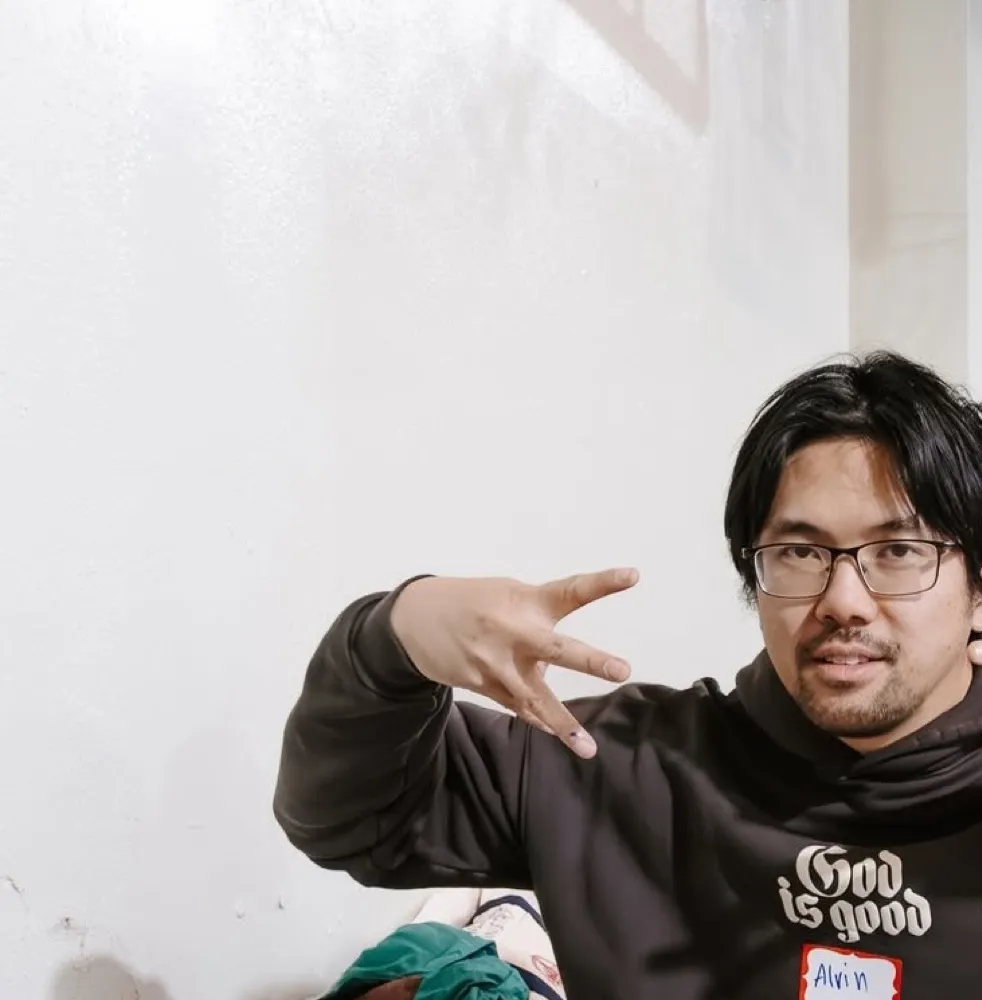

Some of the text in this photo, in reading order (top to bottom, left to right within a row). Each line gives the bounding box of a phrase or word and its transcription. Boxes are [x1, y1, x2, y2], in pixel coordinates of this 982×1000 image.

[795, 845, 903, 898] God
[777, 876, 932, 943] is good
[814, 962, 869, 992] Alvin
